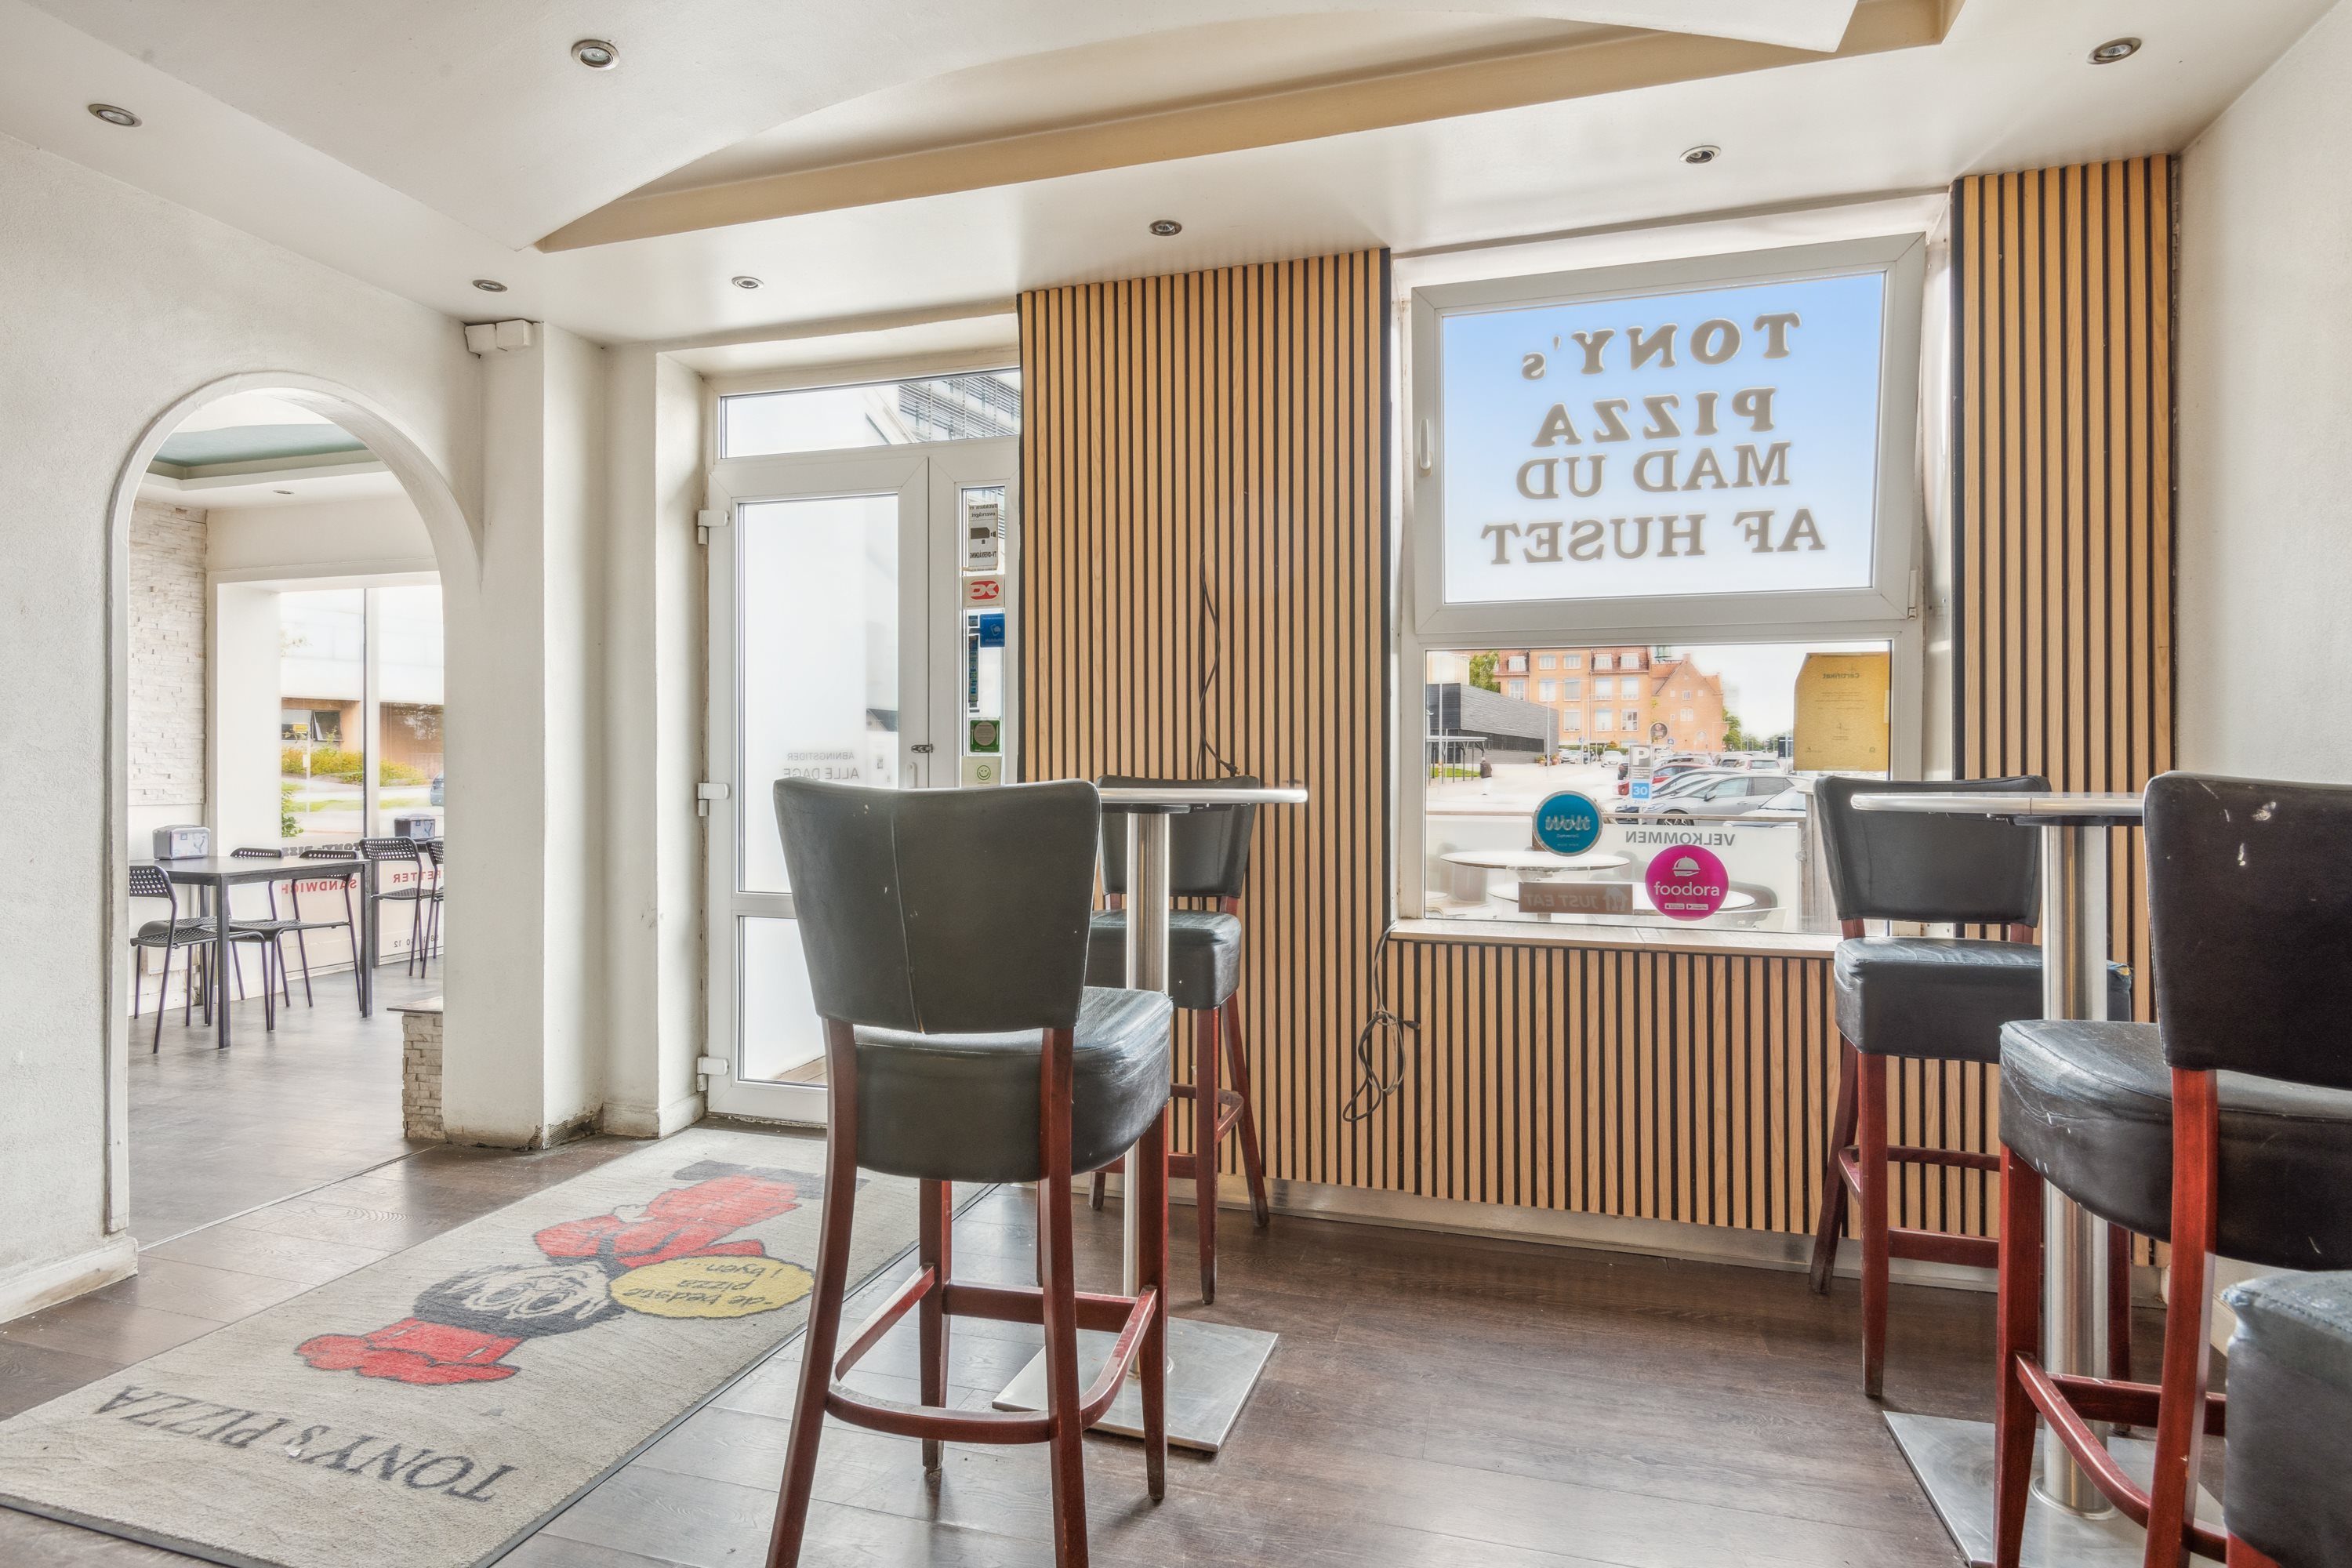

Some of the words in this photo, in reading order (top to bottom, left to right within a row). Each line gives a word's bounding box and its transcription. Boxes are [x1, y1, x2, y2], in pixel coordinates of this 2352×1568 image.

[1632, 747, 1650, 766] P
[1632, 786, 1648, 796] 30
[1653, 881, 1720, 896] foodora
[92, 1385, 292, 1451] PIZZA
